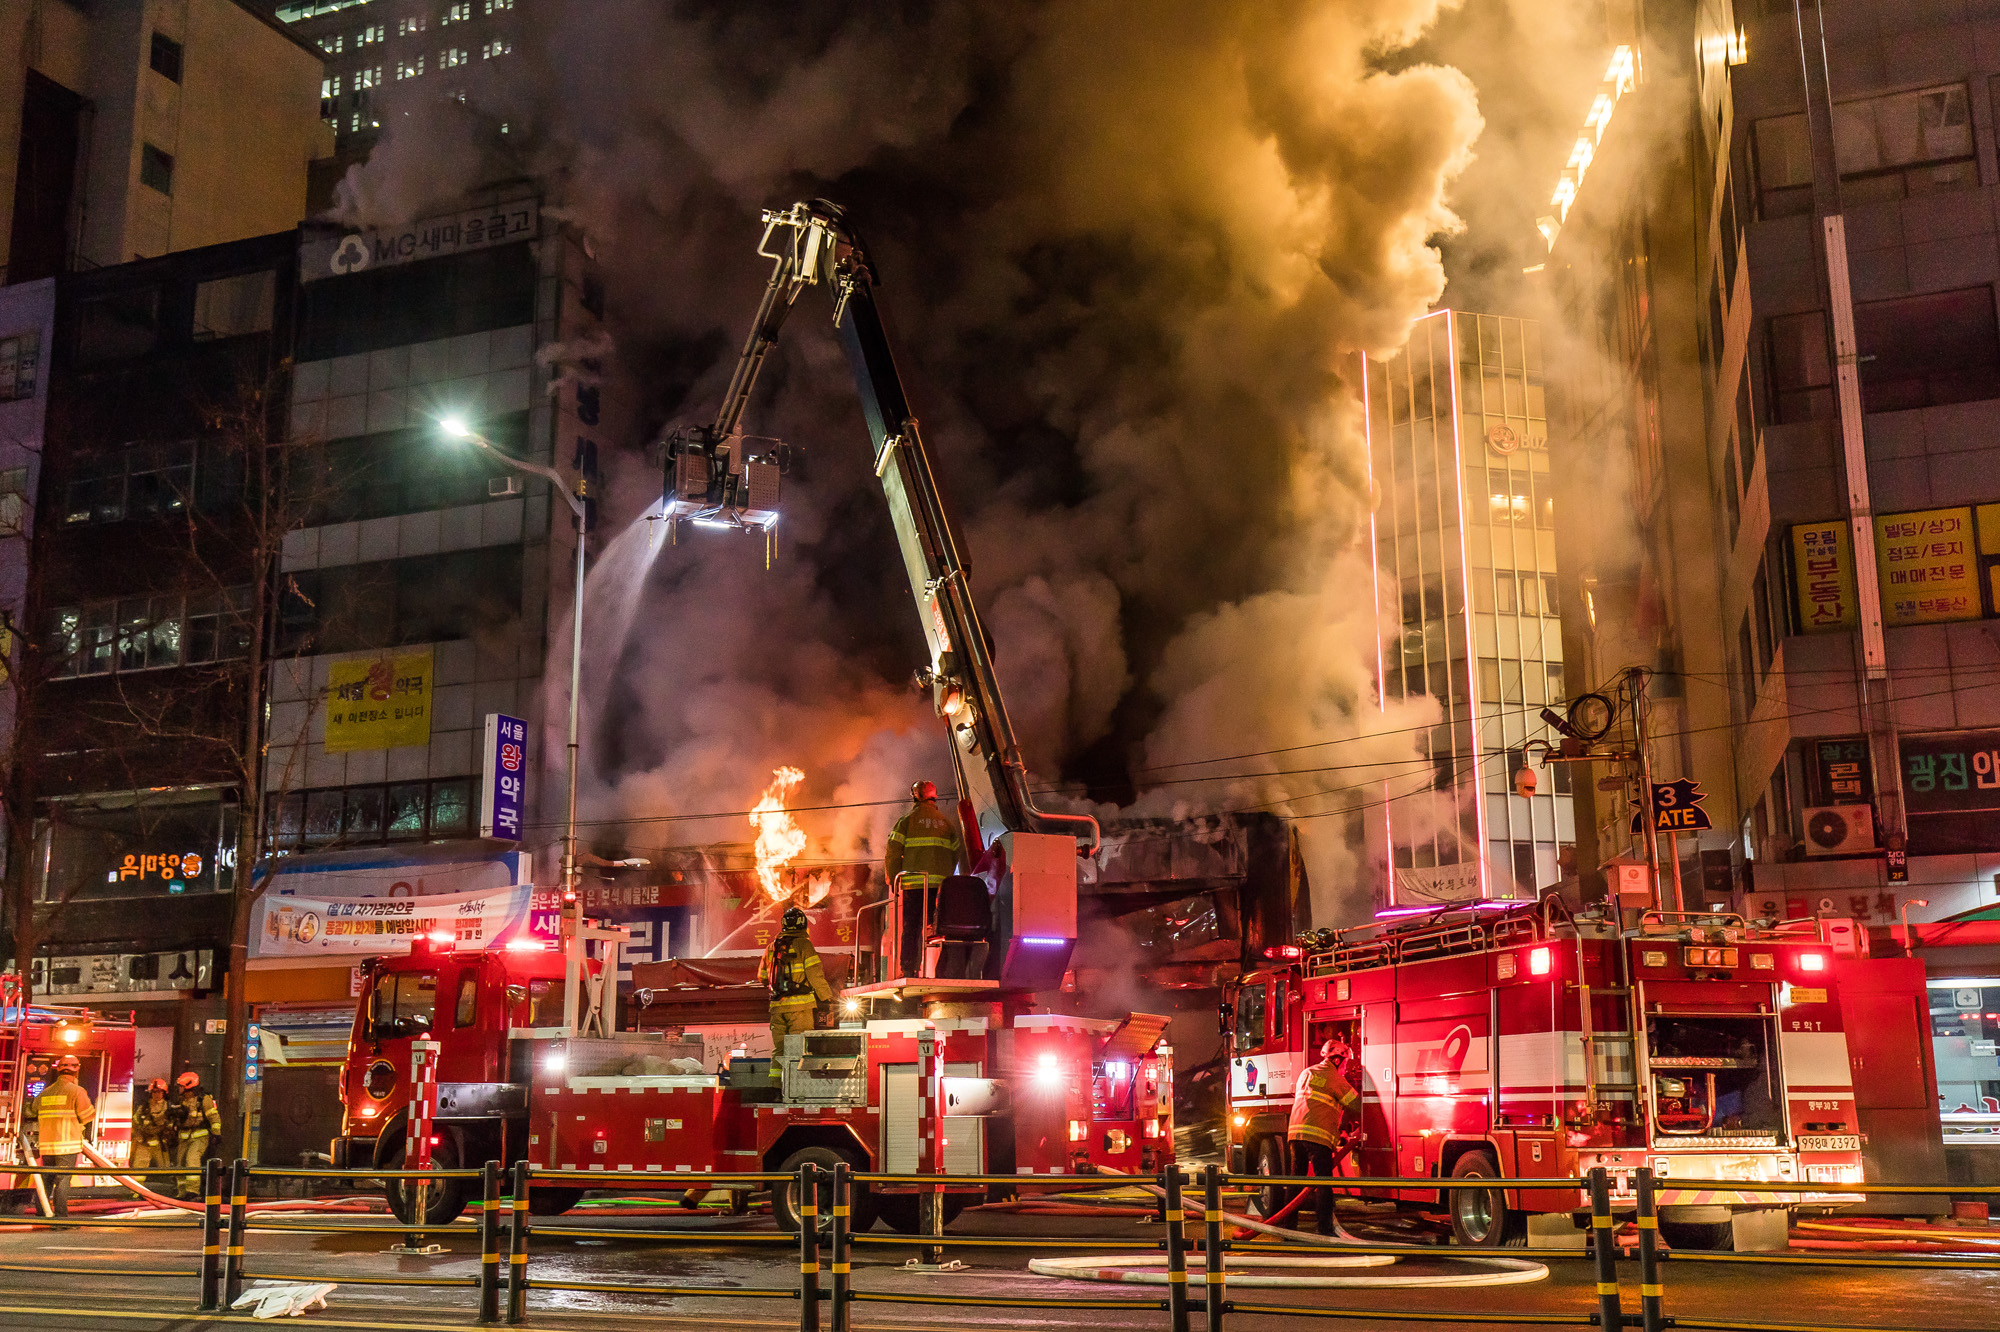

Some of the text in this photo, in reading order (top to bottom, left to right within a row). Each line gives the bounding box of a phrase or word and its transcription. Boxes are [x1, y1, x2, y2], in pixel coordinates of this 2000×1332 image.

[1884, 518, 1961, 539] 빌딩/상가
[1803, 530, 1837, 546] 유림
[1886, 541, 1963, 562] 점포/토지
[1890, 564, 1966, 585] 매매전문
[1807, 557, 1845, 626] 부동산
[1918, 596, 1968, 613] 부동산
[394, 705, 425, 720] 입니다
[500, 721, 524, 742] 서울
[1653, 808, 1697, 827] ATE
[1892, 871, 1904, 880] 2F
[355, 902, 415, 916] 자가점검으로
[1830, 1136, 1857, 1149] 2392
